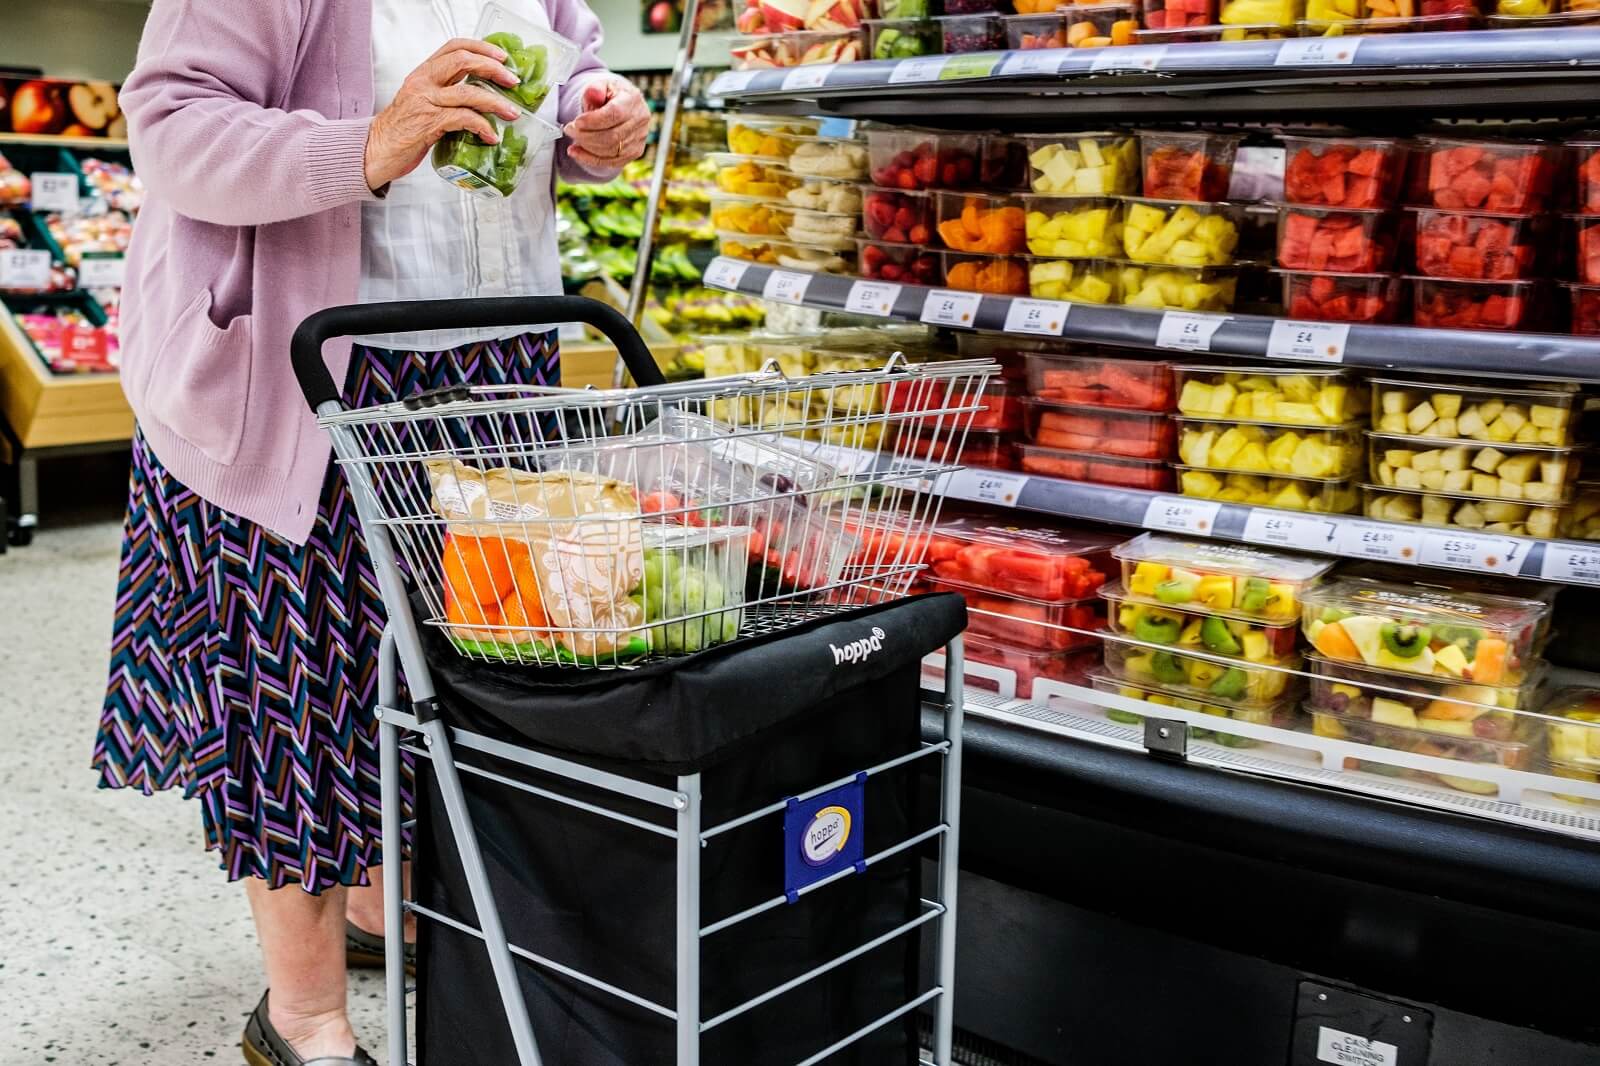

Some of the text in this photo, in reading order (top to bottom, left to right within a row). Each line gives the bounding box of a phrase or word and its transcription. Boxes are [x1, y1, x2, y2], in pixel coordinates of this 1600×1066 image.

[1184, 323, 1199, 334] £4
[1296, 332, 1313, 343] £4
[1344, 1036, 1374, 1051] CASE
[1331, 1041, 1384, 1063] CLEANING
